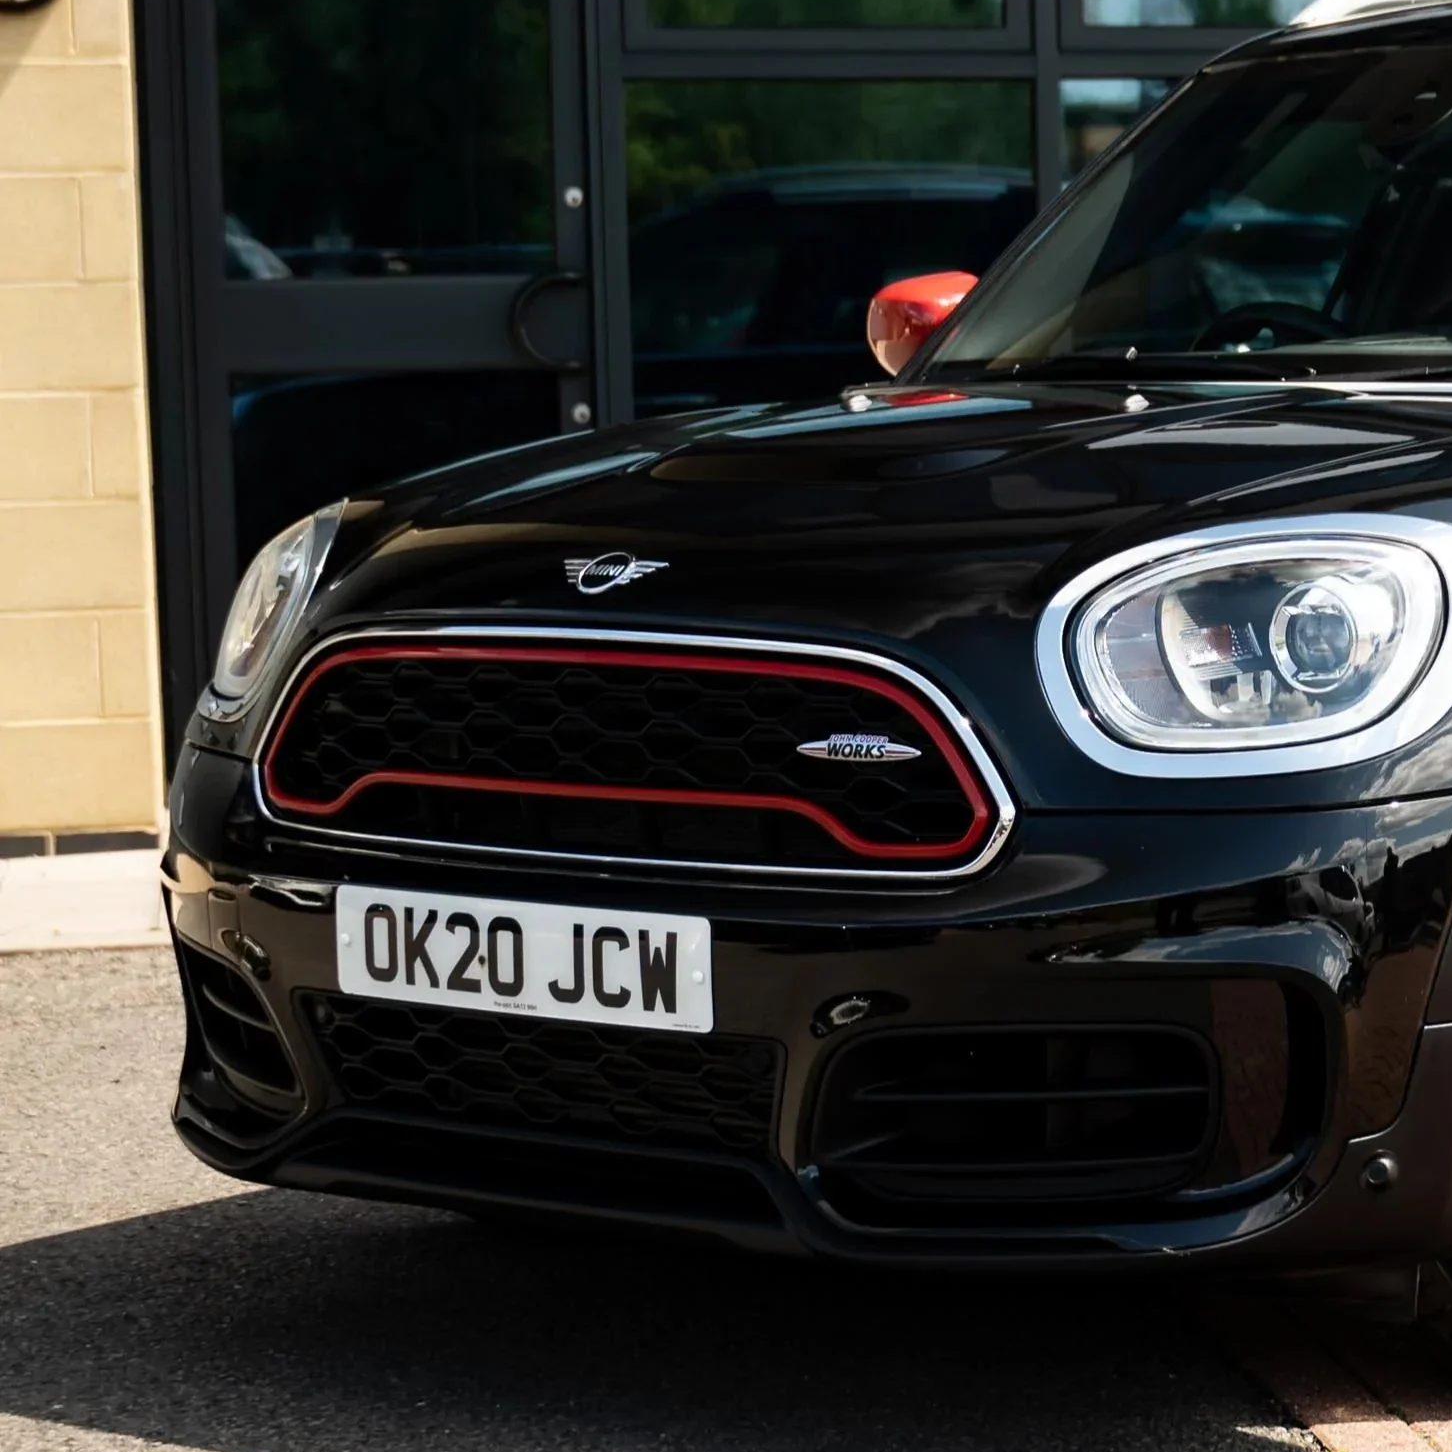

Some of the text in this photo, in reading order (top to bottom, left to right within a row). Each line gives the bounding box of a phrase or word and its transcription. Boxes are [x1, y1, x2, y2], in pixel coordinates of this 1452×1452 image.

[585, 563, 625, 577] MINI
[829, 734, 888, 744] JOHN COOPER
[826, 742, 886, 759] WORKS
[364, 902, 678, 1014] OK20 JCW
